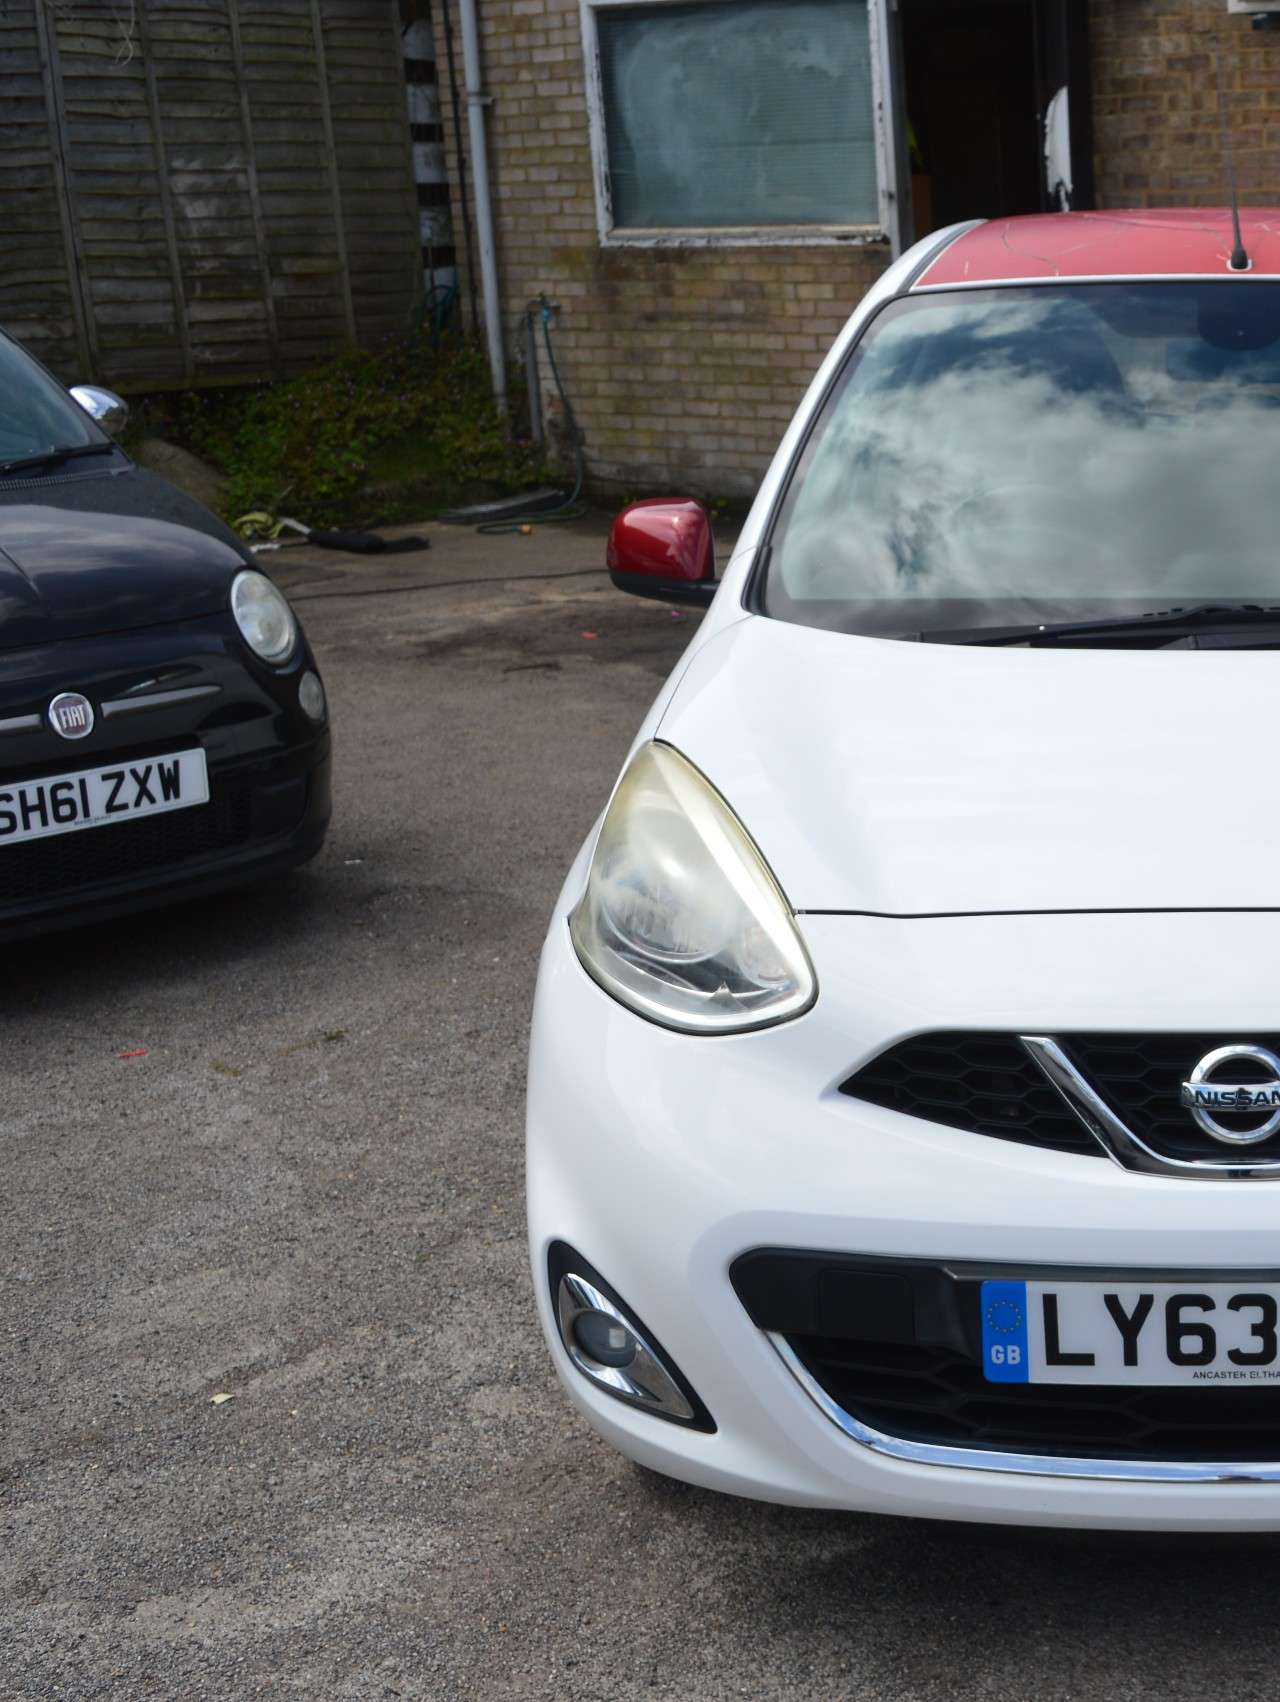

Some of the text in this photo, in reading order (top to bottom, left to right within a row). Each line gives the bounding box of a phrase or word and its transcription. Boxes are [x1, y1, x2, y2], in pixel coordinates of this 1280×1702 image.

[58, 703, 86, 730] FIAT
[0, 759, 181, 836] SH61 ZXW
[990, 1344, 1021, 1365] GB
[1042, 1291, 1278, 1367] LY63
